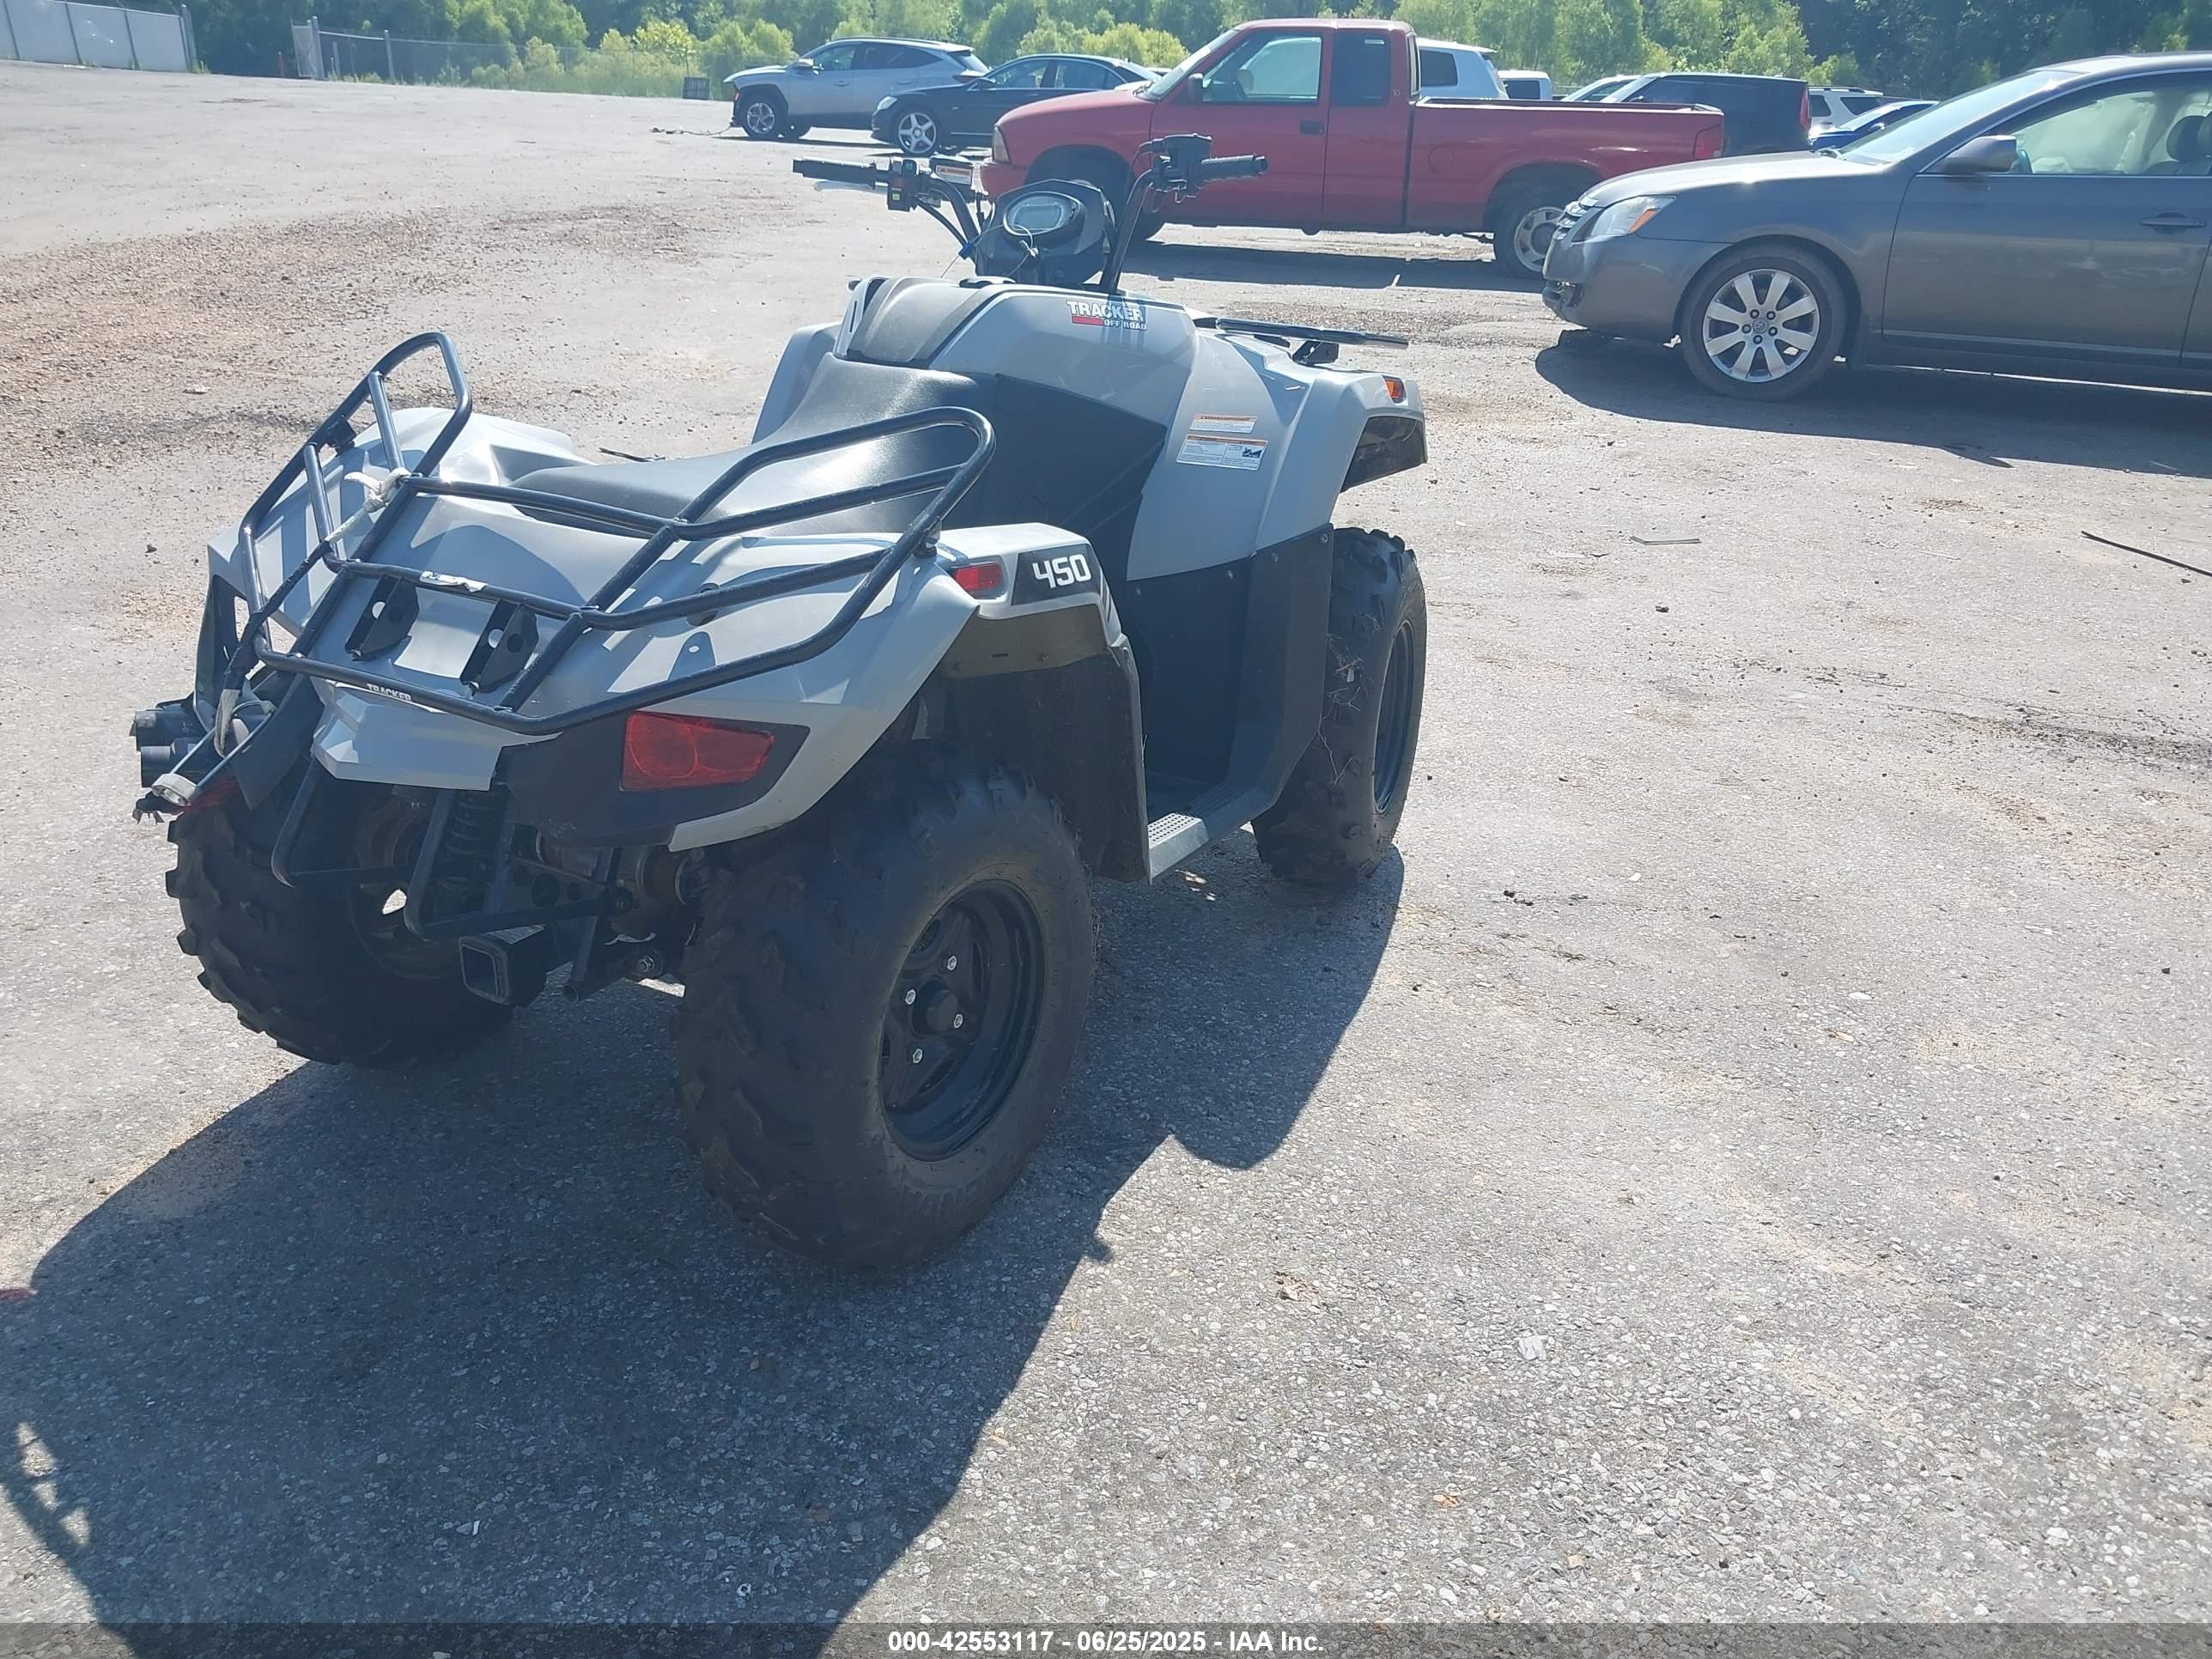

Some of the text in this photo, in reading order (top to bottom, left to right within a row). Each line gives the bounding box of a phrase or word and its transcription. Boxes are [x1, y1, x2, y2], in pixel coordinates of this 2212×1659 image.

[1066, 301, 1145, 322] TRACKER
[1103, 318, 1147, 331] OFF ROAD
[1032, 554, 1091, 589] 450
